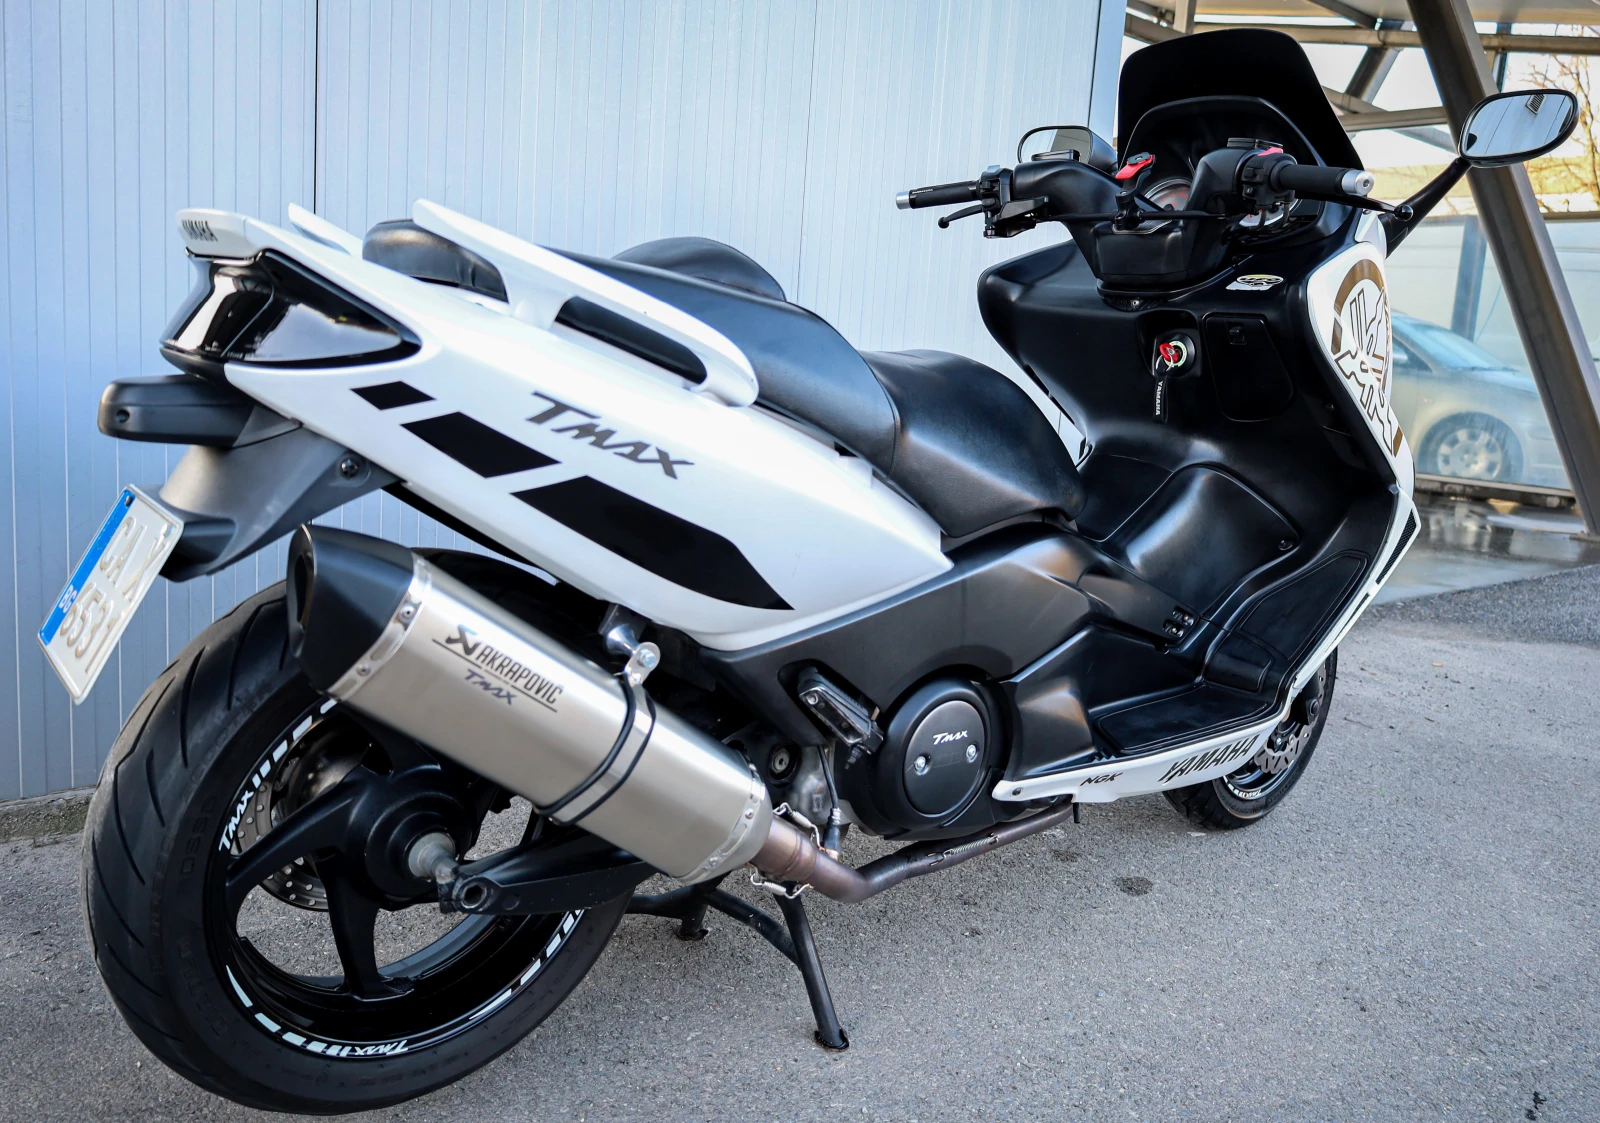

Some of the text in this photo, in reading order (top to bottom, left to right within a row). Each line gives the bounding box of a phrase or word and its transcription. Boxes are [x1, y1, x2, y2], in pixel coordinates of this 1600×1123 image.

[1155, 381, 1163, 415] YAMAHA
[525, 390, 695, 480] TMAX
[58, 584, 78, 614] BG
[465, 668, 516, 705] TMAX
[1158, 734, 1260, 784] YAMAHA
[1079, 772, 1124, 786] NGK
[219, 790, 254, 851] TMAX
